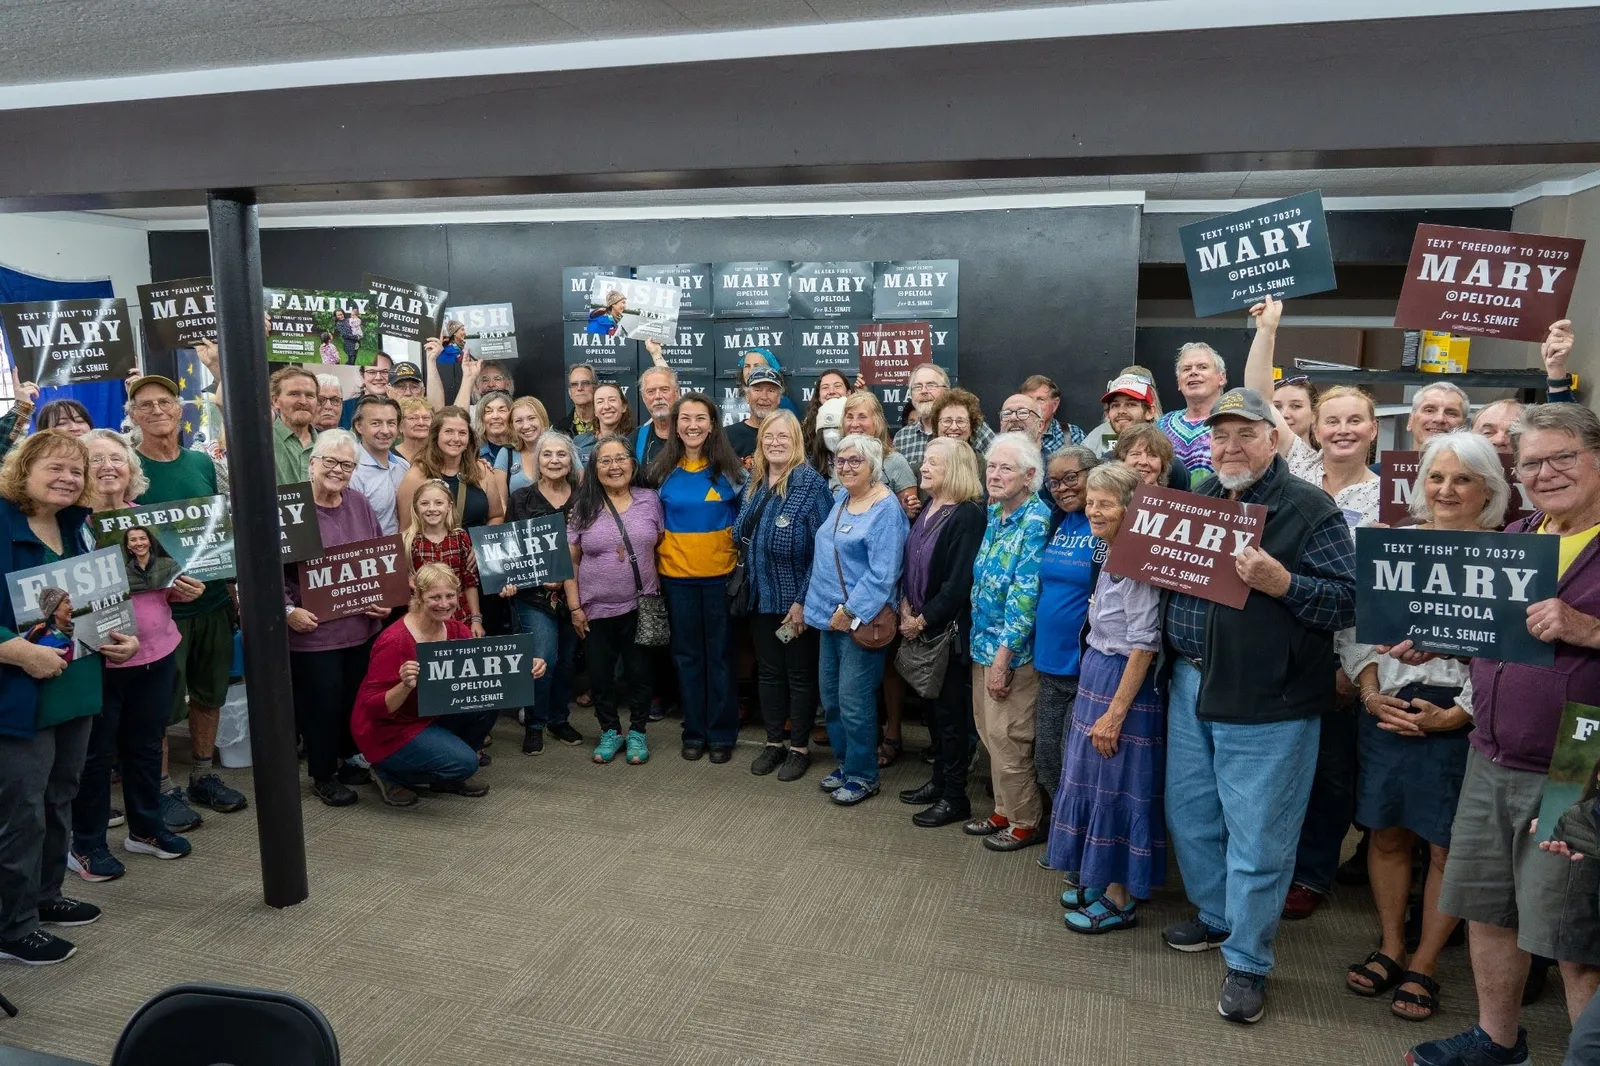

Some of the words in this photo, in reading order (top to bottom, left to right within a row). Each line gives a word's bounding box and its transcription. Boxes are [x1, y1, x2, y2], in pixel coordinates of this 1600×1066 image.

[1201, 229, 1222, 241] TEXT
[1226, 220, 1254, 235] "FISH"
[1258, 216, 1270, 226] TO
[1273, 208, 1300, 222] 70379
[1196, 220, 1312, 272] MARY
[1427, 238, 1453, 249] TEXT
[1458, 241, 1516, 255] "FREEDOM"
[1520, 248, 1533, 256] TO
[1538, 250, 1569, 260] 70379
[1240, 258, 1290, 279] PELTOLA
[1417, 253, 1566, 294] MARY
[723, 273, 782, 288] MARY
[798, 277, 866, 292] MARY
[884, 272, 948, 288] MARY
[1232, 290, 1247, 300] for
[1249, 284, 1265, 294] U.S.
[1267, 276, 1295, 290] SENATE
[151, 290, 169, 298] TEXT
[172, 286, 203, 295] "FAMILY"
[388, 286, 412, 294] "FAMILY"
[600, 280, 676, 308] FISH
[151, 295, 216, 320] MAR
[271, 294, 369, 314] FAMILY
[369, 290, 438, 318] MARY
[1459, 292, 1521, 308] PELTOLA
[18, 312, 39, 320] TEXT
[42, 310, 79, 319] "FAMILY"
[185, 317, 216, 327] PELTO
[389, 313, 419, 324] PELTOLA
[1439, 311, 1458, 320] for
[1462, 312, 1481, 323] U.S.
[1484, 314, 1519, 327] SENATE
[18, 321, 120, 348] MARY
[272, 322, 314, 332] MARY
[402, 326, 419, 334] SENATE
[480, 331, 509, 339] MARY
[178, 333, 191, 341] for
[573, 333, 626, 346] MARY
[724, 332, 783, 348] MARY
[802, 332, 858, 346] MARY
[62, 348, 105, 360] PELTOLA
[862, 339, 925, 356] MARY
[71, 364, 84, 373] U.S.
[86, 363, 108, 372] SENATE
[1393, 464, 1420, 475] TEXT
[278, 492, 300, 501] 70379
[100, 502, 223, 533] FREEDOM
[1142, 496, 1164, 506] TEXT
[1167, 501, 1216, 518] "FREEDOM"
[1219, 511, 1230, 521] TO
[1233, 514, 1257, 527] 70379
[532, 524, 551, 532] 70379
[1129, 508, 1254, 560] MARY
[180, 531, 226, 547] MARY
[481, 532, 559, 562] MARY
[306, 557, 323, 566] TEXT
[326, 549, 362, 561] "FREEDOM"
[377, 543, 396, 552] 70379
[1161, 546, 1214, 568] PELTOLA
[1384, 543, 1413, 554] TEXT
[1418, 545, 1459, 556] "FISH"
[1464, 547, 1480, 557] TO
[1486, 548, 1525, 560] 70379
[306, 554, 398, 590] MARY
[510, 558, 545, 570] PELTOLA
[528, 570, 548, 578] SENATE
[1141, 563, 1159, 572] for
[1161, 566, 1177, 577] U.S.
[1178, 570, 1210, 585] SENATE
[1372, 559, 1538, 602] MARY
[17, 553, 122, 612] FISH
[340, 581, 380, 595] PELTOLA
[91, 591, 125, 612] MARY
[346, 599, 360, 607] U.S.
[361, 594, 383, 604] SENATE
[1425, 602, 1494, 621] PELTOLA
[1407, 624, 1429, 636] for
[1432, 626, 1454, 639] U.S.
[1457, 628, 1496, 643] SENATE
[428, 654, 523, 680] MARY
[461, 680, 502, 690] PELTOLA
[451, 698, 464, 706] for
